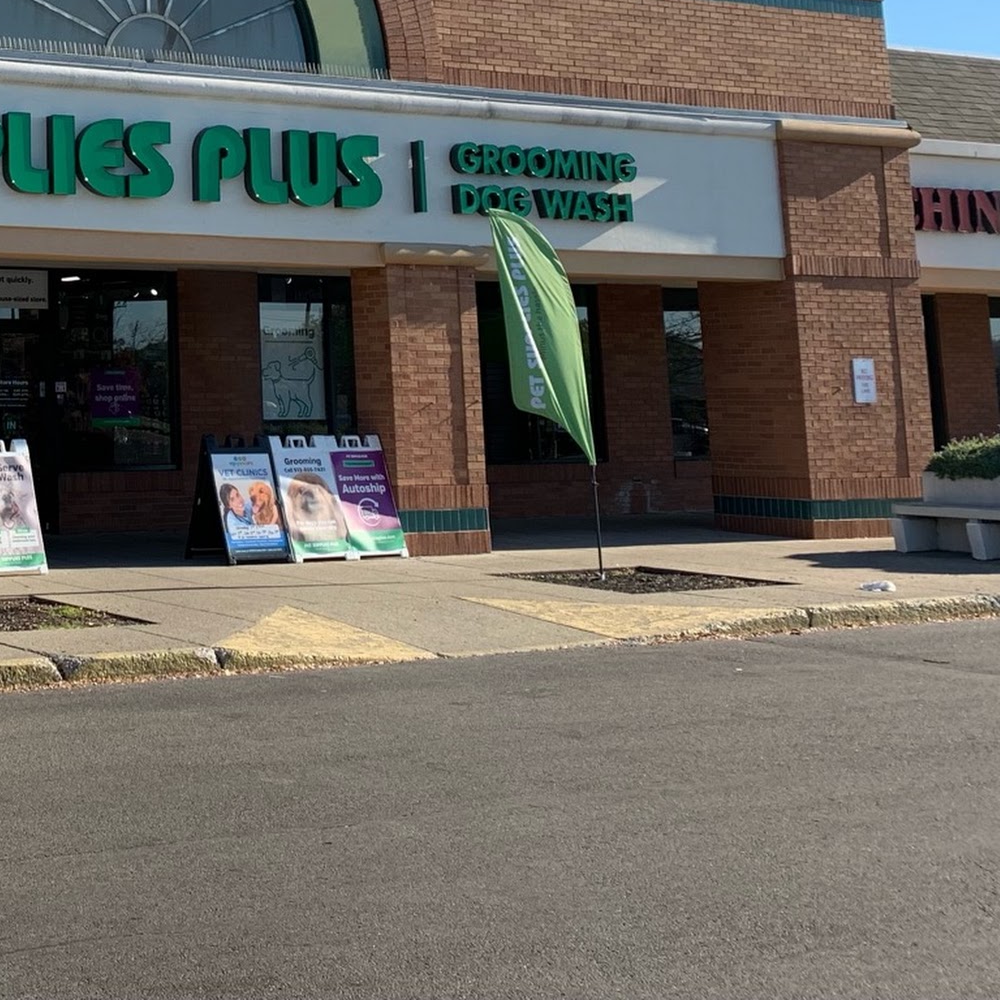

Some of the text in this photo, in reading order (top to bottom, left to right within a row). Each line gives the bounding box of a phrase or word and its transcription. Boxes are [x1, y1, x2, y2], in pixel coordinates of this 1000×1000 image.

[192, 124, 383, 209] PLUS
[450, 141, 637, 183] GROOMING
[451, 182, 634, 222] DOG WASH
[912, 186, 1000, 234] HIN
[6, 275, 34, 285] quickly.
[528, 374, 547, 410] PET
[6, 420, 16, 430] IN
[236, 468, 268, 476] CLINICS
[284, 456, 322, 466] Grooming
[342, 482, 386, 495] Autoship
